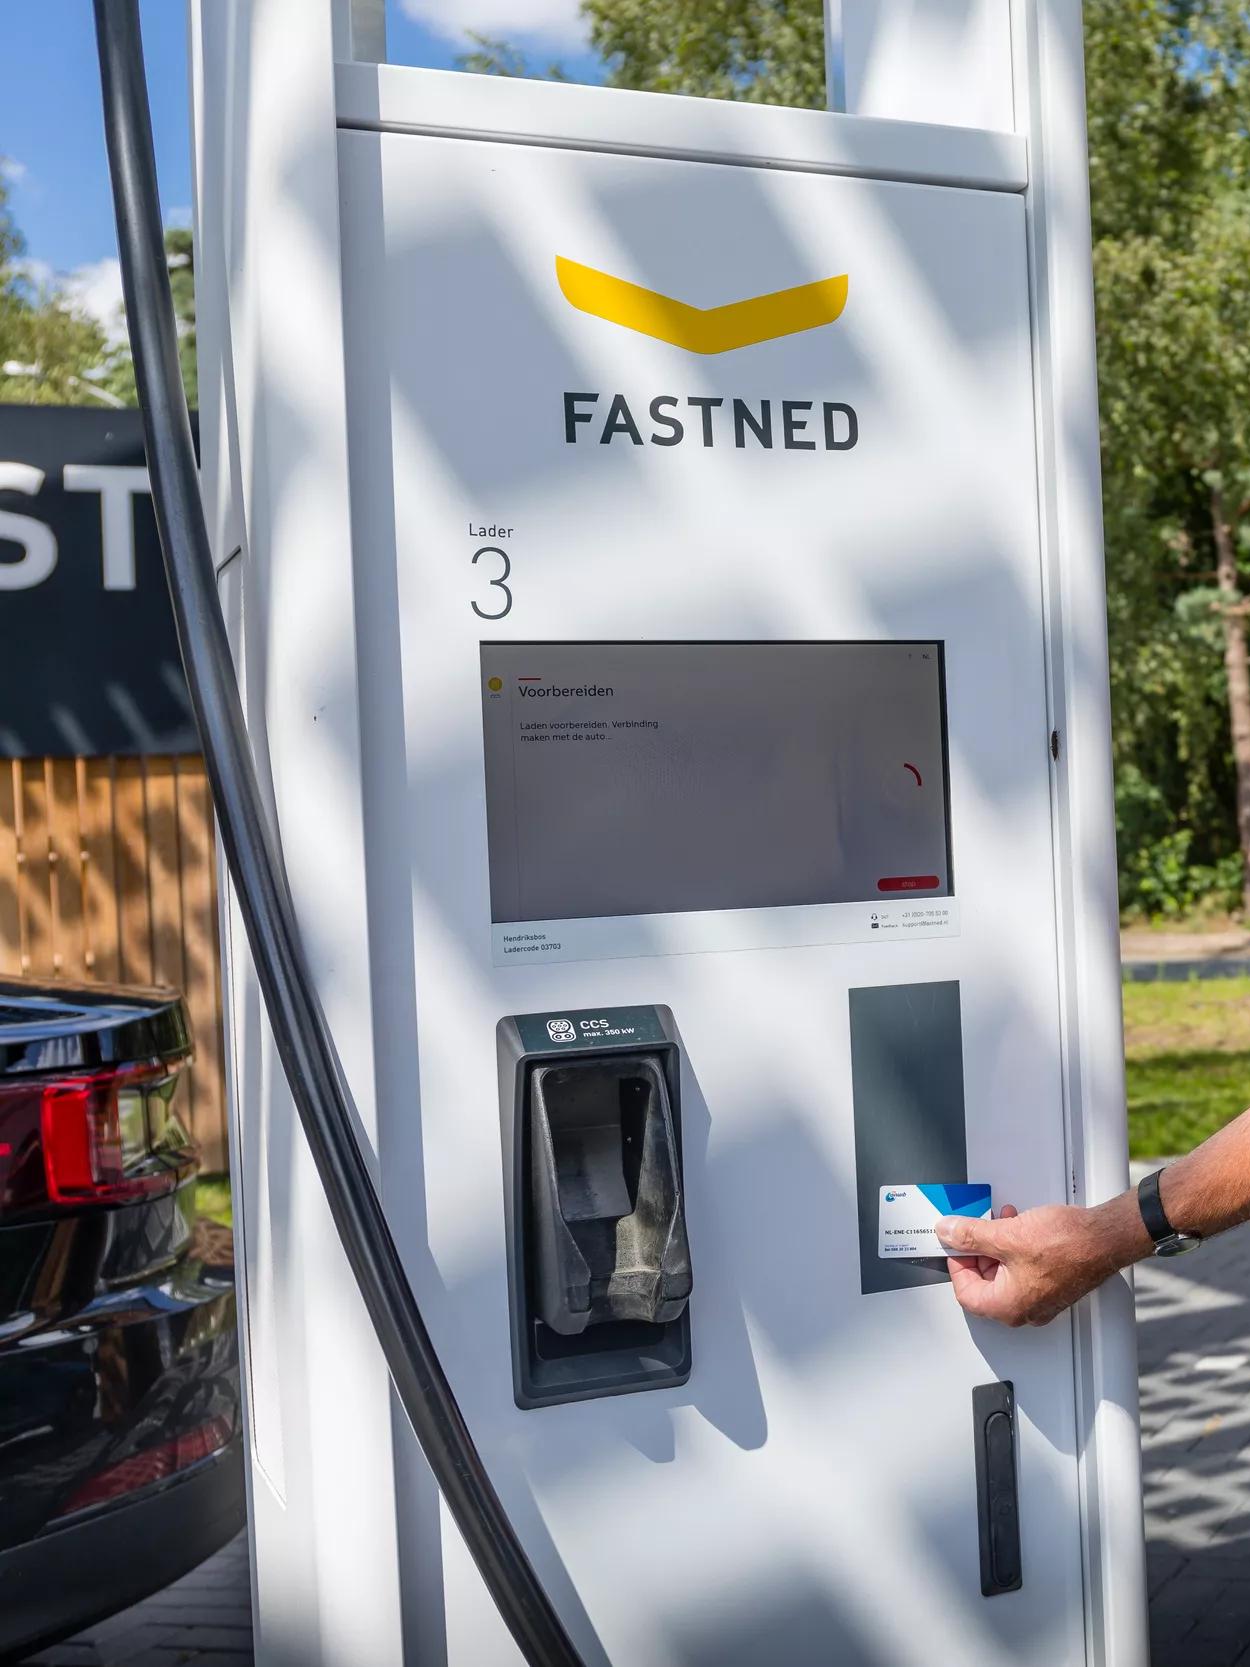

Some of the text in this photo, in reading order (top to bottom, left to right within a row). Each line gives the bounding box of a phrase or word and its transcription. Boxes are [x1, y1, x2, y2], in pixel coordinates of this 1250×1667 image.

[563, 391, 859, 451] FASTNED
[468, 522, 514, 538] Lader
[470, 546, 513, 620] 3
[518, 684, 614, 698] Voorbereiden
[520, 720, 659, 730] Laden voorbereiden. Verbinding
[572, 733, 583, 741] de
[503, 944, 540, 953] Ladercode
[580, 1019, 609, 1029] CCS
[605, 1028, 620, 1036] 350
